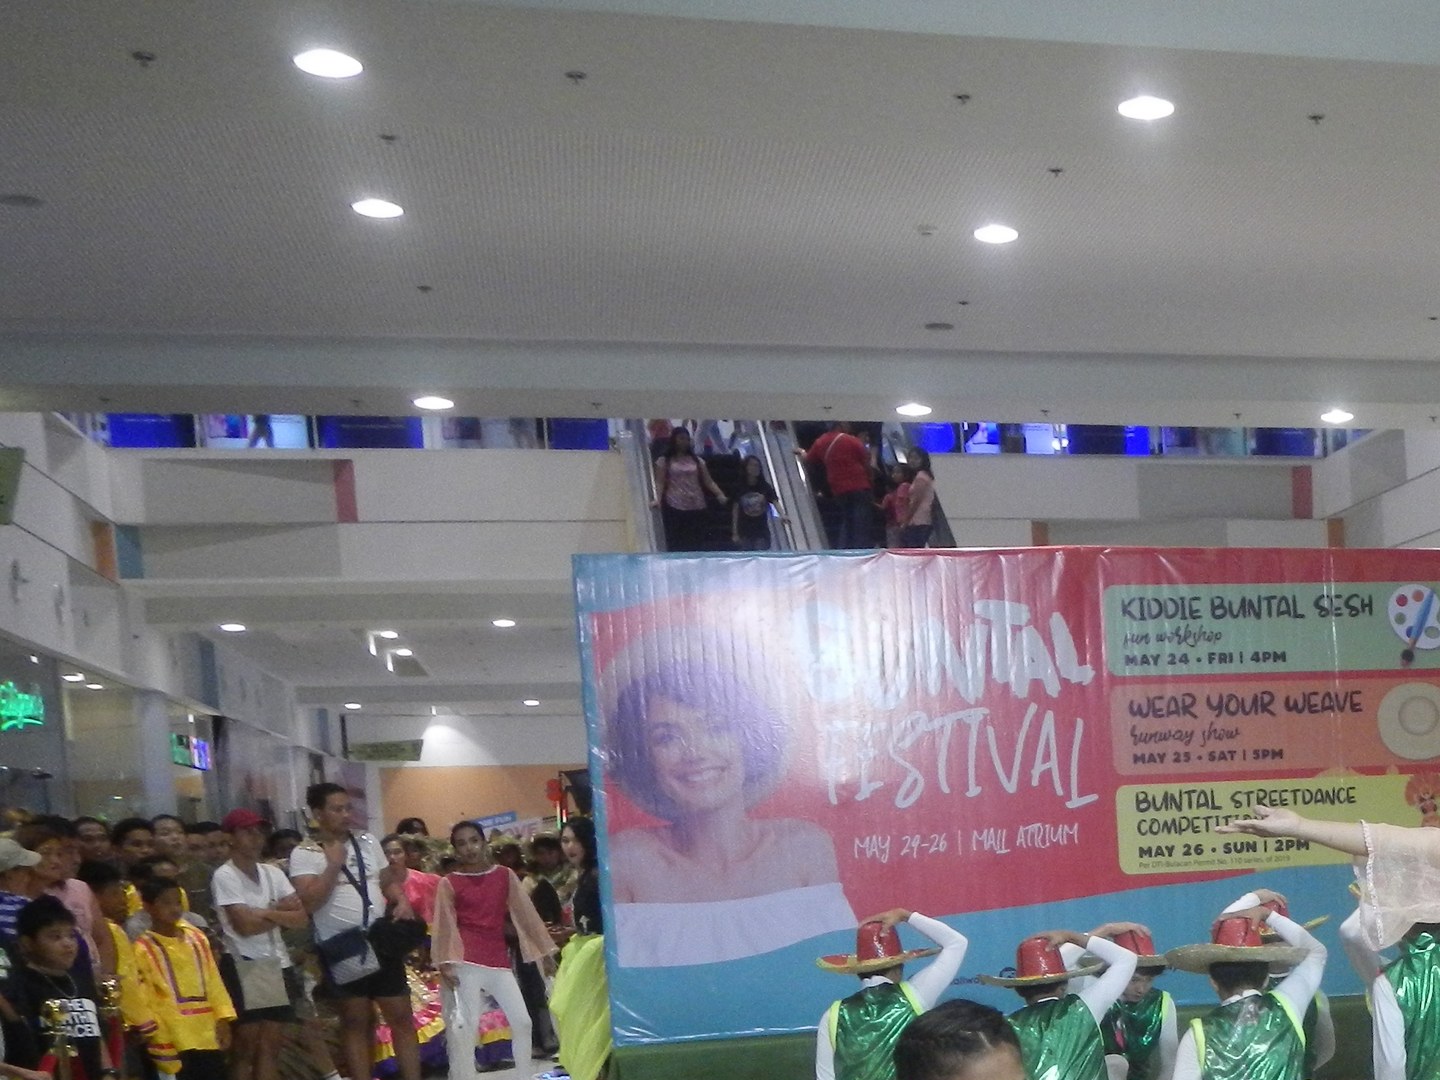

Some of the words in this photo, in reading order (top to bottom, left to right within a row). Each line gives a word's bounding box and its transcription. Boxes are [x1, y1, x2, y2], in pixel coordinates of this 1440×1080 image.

[1121, 595, 1204, 622] KIDDIE
[1210, 594, 1305, 621] BUNTAL
[1313, 593, 1374, 618] SESH
[1155, 623, 1224, 649] workshop
[1124, 653, 1160, 667] MAY
[1167, 653, 1190, 665] 24
[1207, 652, 1234, 665] FRI
[1249, 651, 1287, 664] 4PM
[1128, 693, 1198, 719] WEAR
[1206, 691, 1275, 718] YOUR
[1284, 690, 1364, 715] WEAVE
[1129, 724, 1195, 747] runway
[1201, 721, 1241, 748] show
[822, 702, 1099, 809] FESTIVAL
[1132, 752, 1167, 765] MAY
[1172, 751, 1192, 763] 25
[1208, 750, 1237, 762] SAT
[1252, 748, 1284, 761] 5PM
[1135, 788, 1223, 814] BUNTAL
[1229, 787, 1357, 809] STREETDANCE
[1136, 814, 1264, 837] COMPETIT
[854, 834, 891, 864] MAY
[971, 827, 1011, 854] MALL
[1016, 822, 1079, 849] ATRIUM
[1138, 845, 1176, 859] MAY
[1182, 843, 1204, 857] 26
[1223, 841, 1258, 855] SUN
[1274, 839, 1310, 853] 2PM
